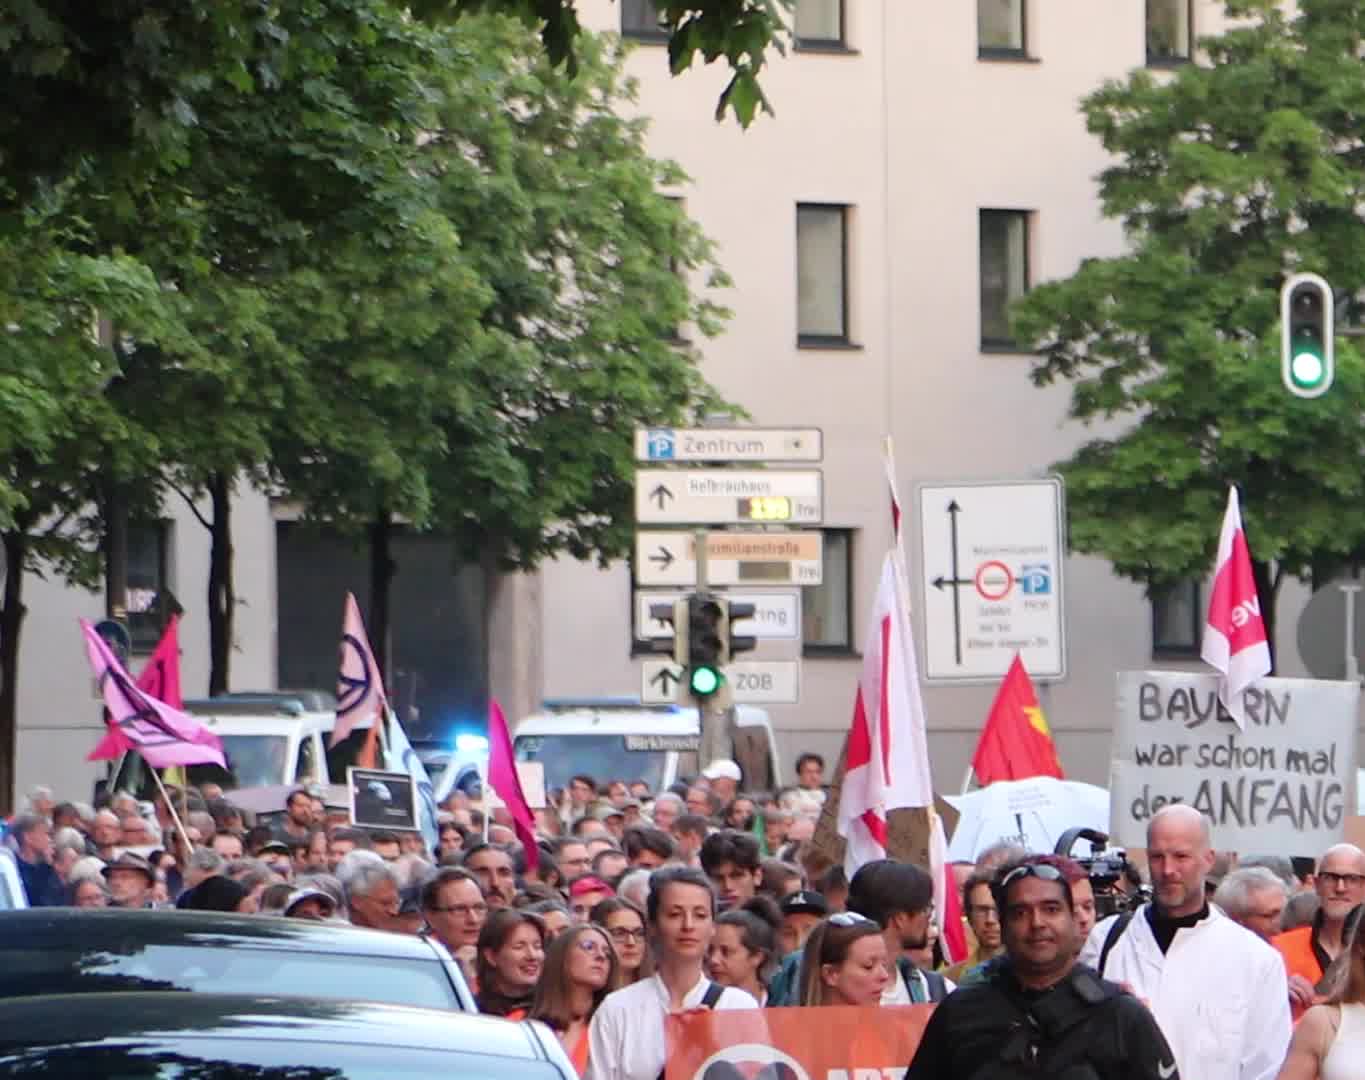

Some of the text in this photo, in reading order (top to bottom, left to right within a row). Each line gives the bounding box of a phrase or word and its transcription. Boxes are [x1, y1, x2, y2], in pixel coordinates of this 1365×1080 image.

[684, 437, 765, 454] Zentrum
[736, 673, 773, 690] ZOB
[1135, 735, 1336, 776] war schon mal
[1193, 776, 1344, 830] ANFANG
